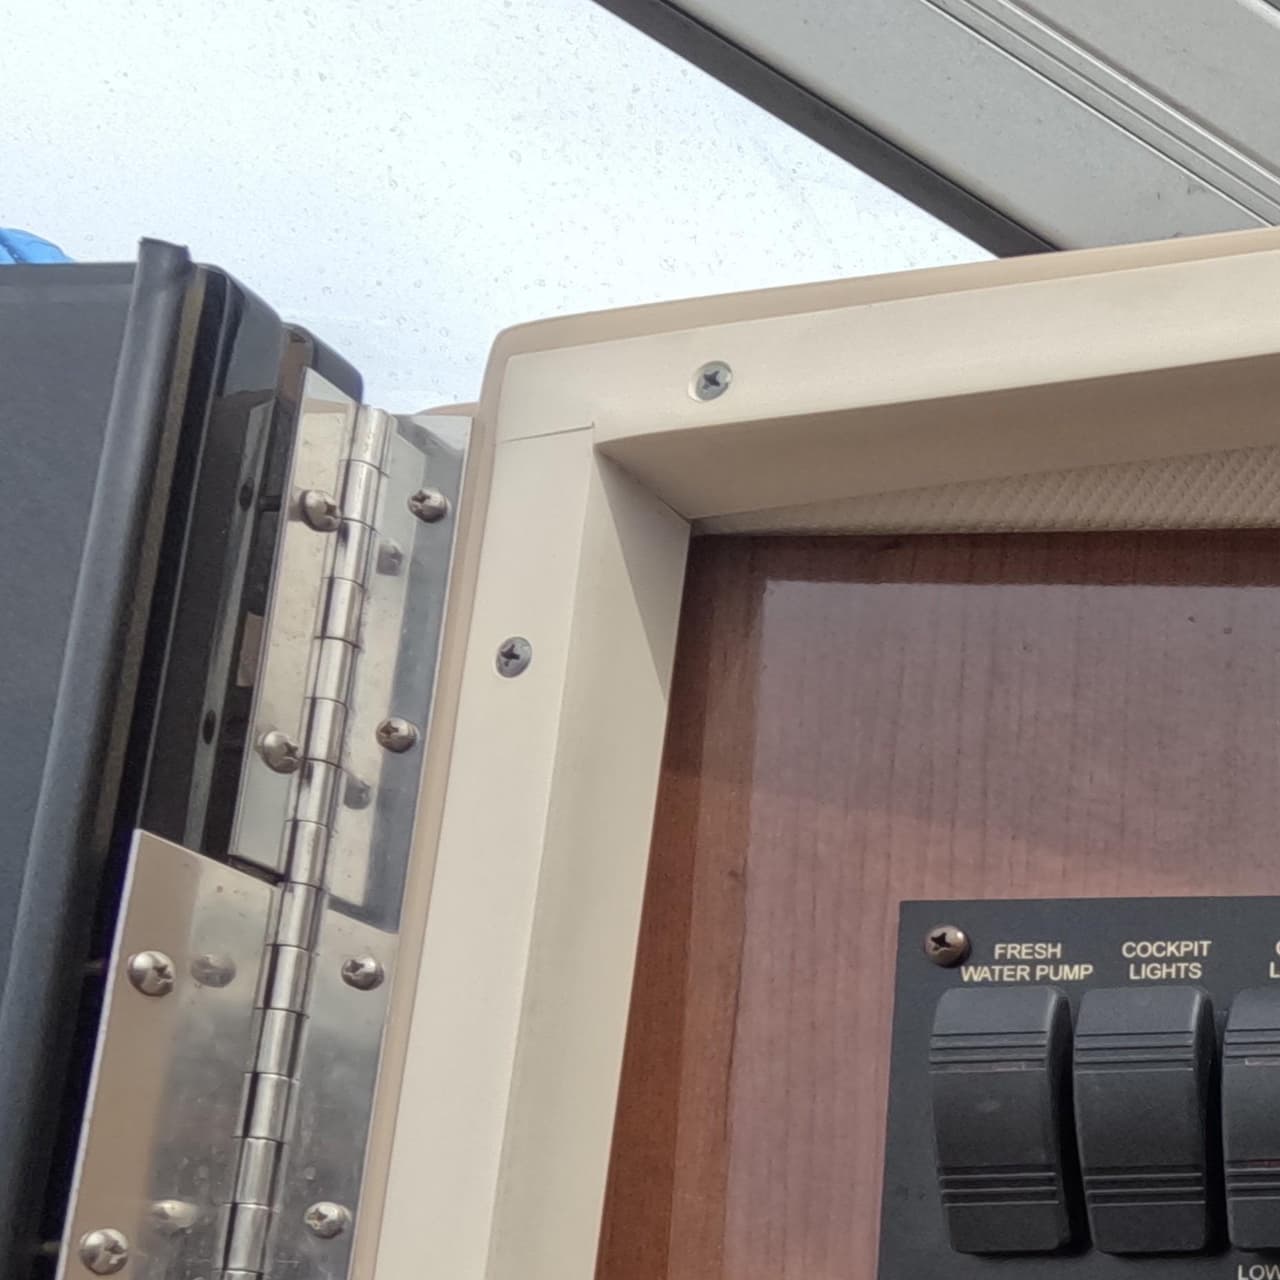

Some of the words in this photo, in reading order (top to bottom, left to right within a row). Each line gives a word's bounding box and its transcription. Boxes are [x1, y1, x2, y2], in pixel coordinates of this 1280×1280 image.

[994, 942, 1062, 960] FRESH
[1121, 940, 1212, 959] COCKPIT
[961, 963, 1033, 982] WATER
[1035, 963, 1094, 982] PUMP
[1127, 961, 1203, 980] LIGHTS
